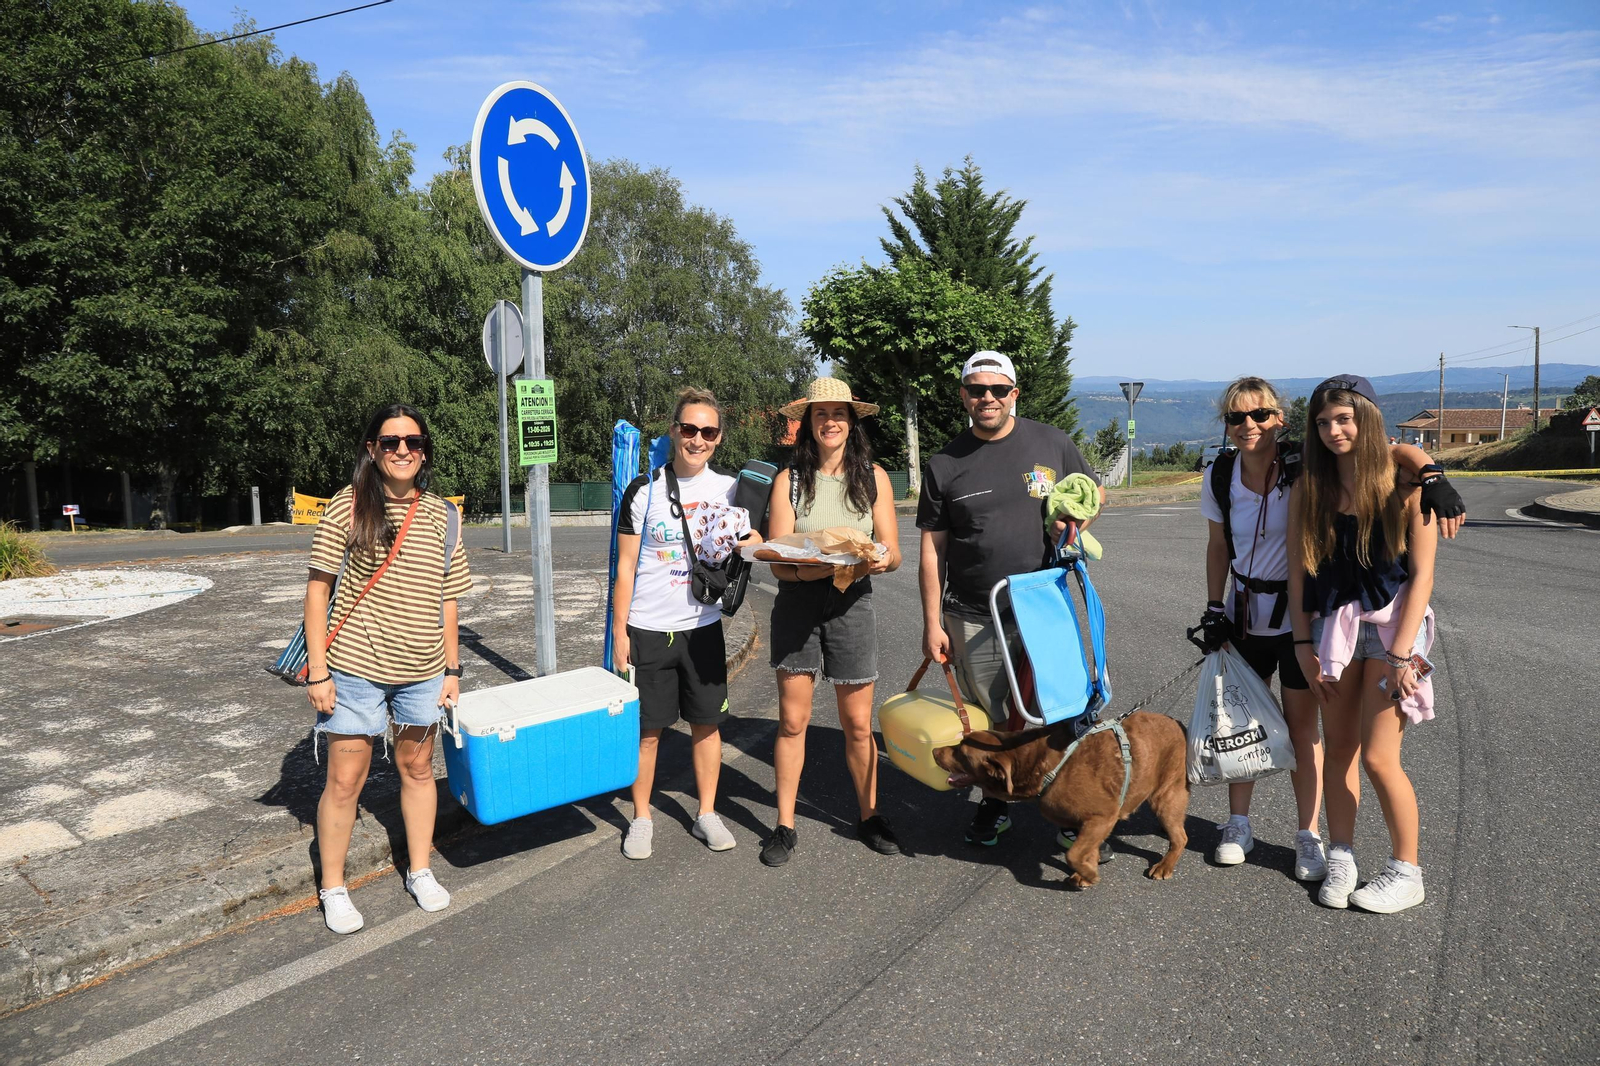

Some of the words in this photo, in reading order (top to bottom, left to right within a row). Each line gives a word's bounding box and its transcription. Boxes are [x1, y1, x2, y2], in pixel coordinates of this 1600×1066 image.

[521, 397, 548, 406] ATENCION
[1216, 728, 1263, 750] EROSKI
[1238, 746, 1270, 762] contgo
